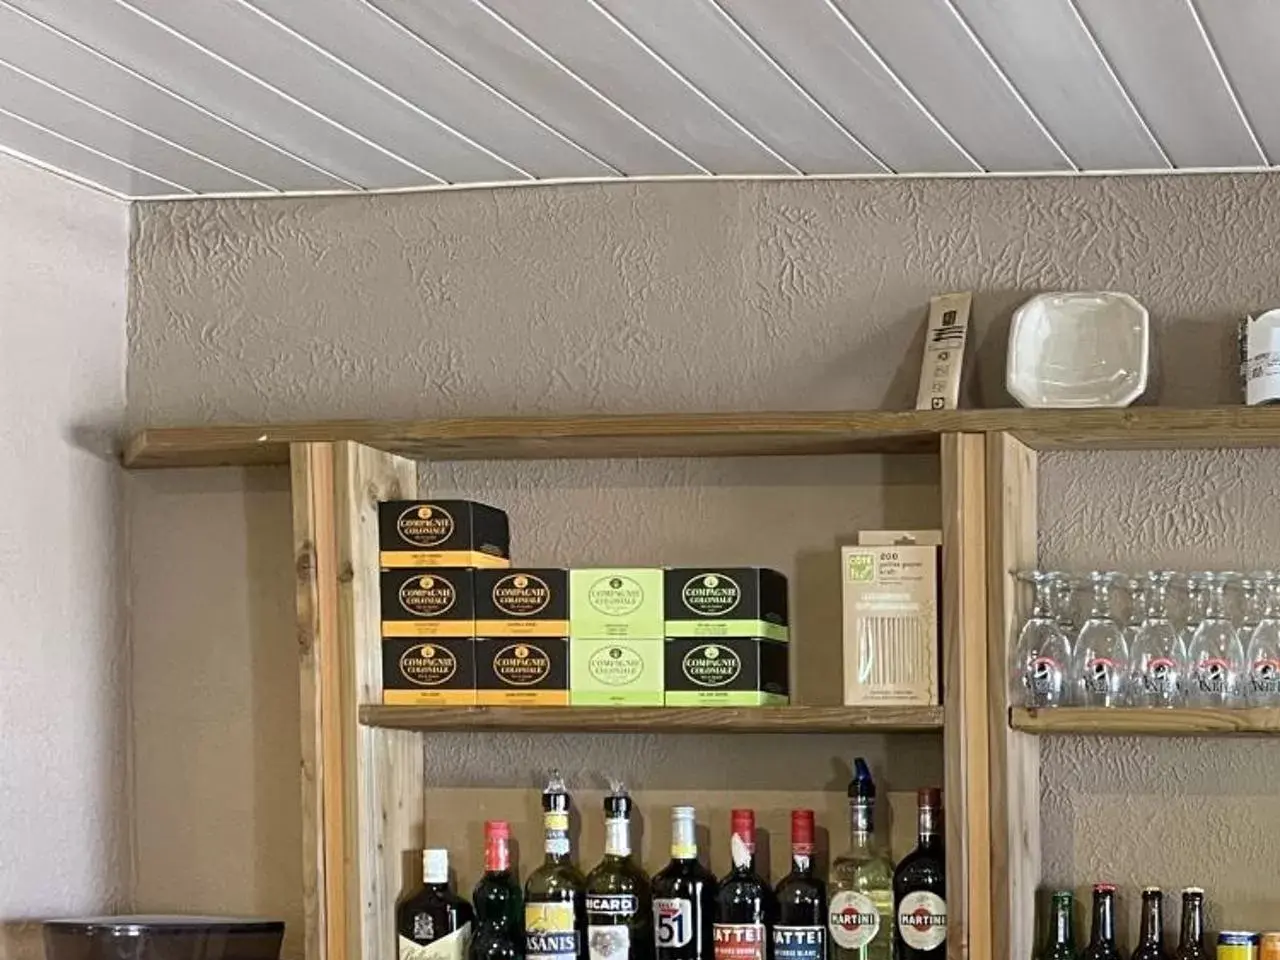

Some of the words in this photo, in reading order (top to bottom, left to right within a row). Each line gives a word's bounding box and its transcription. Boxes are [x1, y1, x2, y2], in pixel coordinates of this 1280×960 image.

[685, 588, 737, 597] COMPAGNIE
[686, 659, 737, 668] COMPAGNIE
[690, 667, 733, 675] COLONIALE
[832, 914, 874, 925] MARTINI
[902, 915, 946, 925] MARTINI
[659, 914, 684, 943] 51
